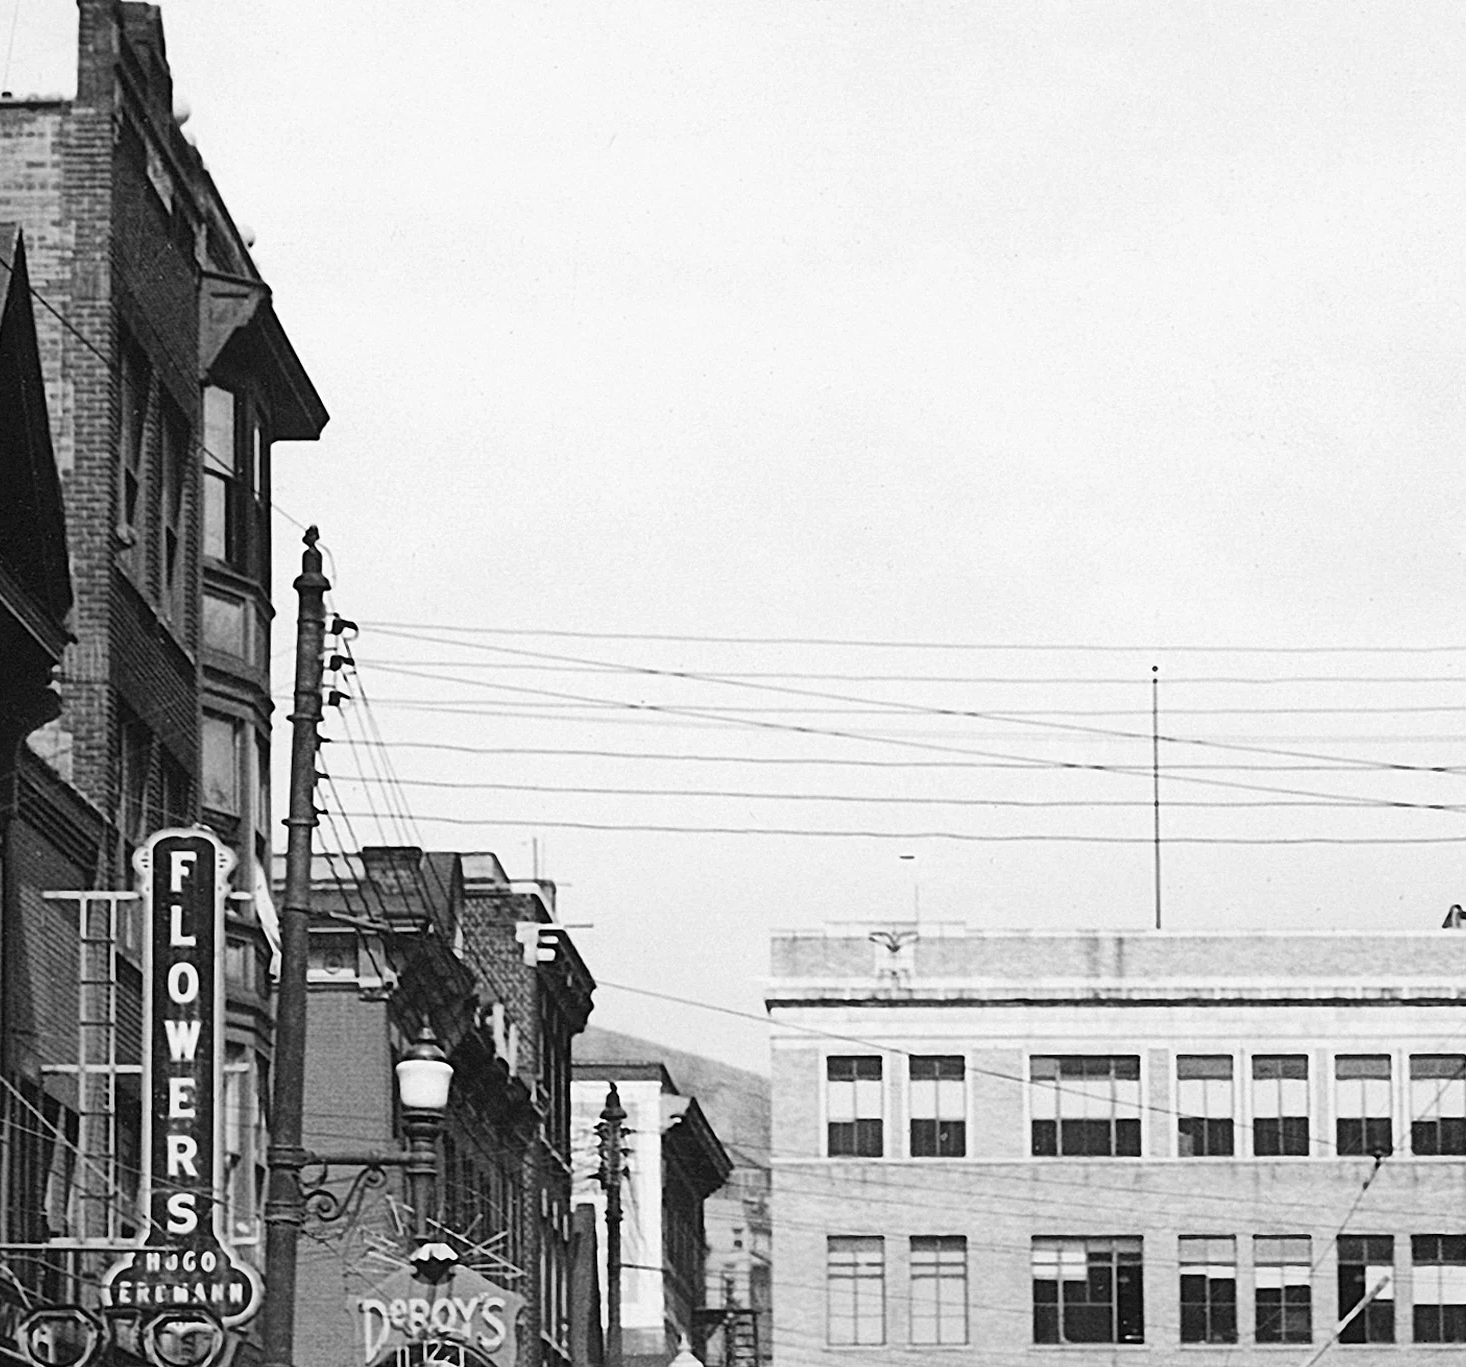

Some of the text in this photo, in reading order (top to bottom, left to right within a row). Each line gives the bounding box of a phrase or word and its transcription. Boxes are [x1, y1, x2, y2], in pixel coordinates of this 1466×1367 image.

[164, 850, 202, 1235] FLOWERS
[146, 1251, 218, 1273] HUGO
[422, 1338, 443, 1364] 12
